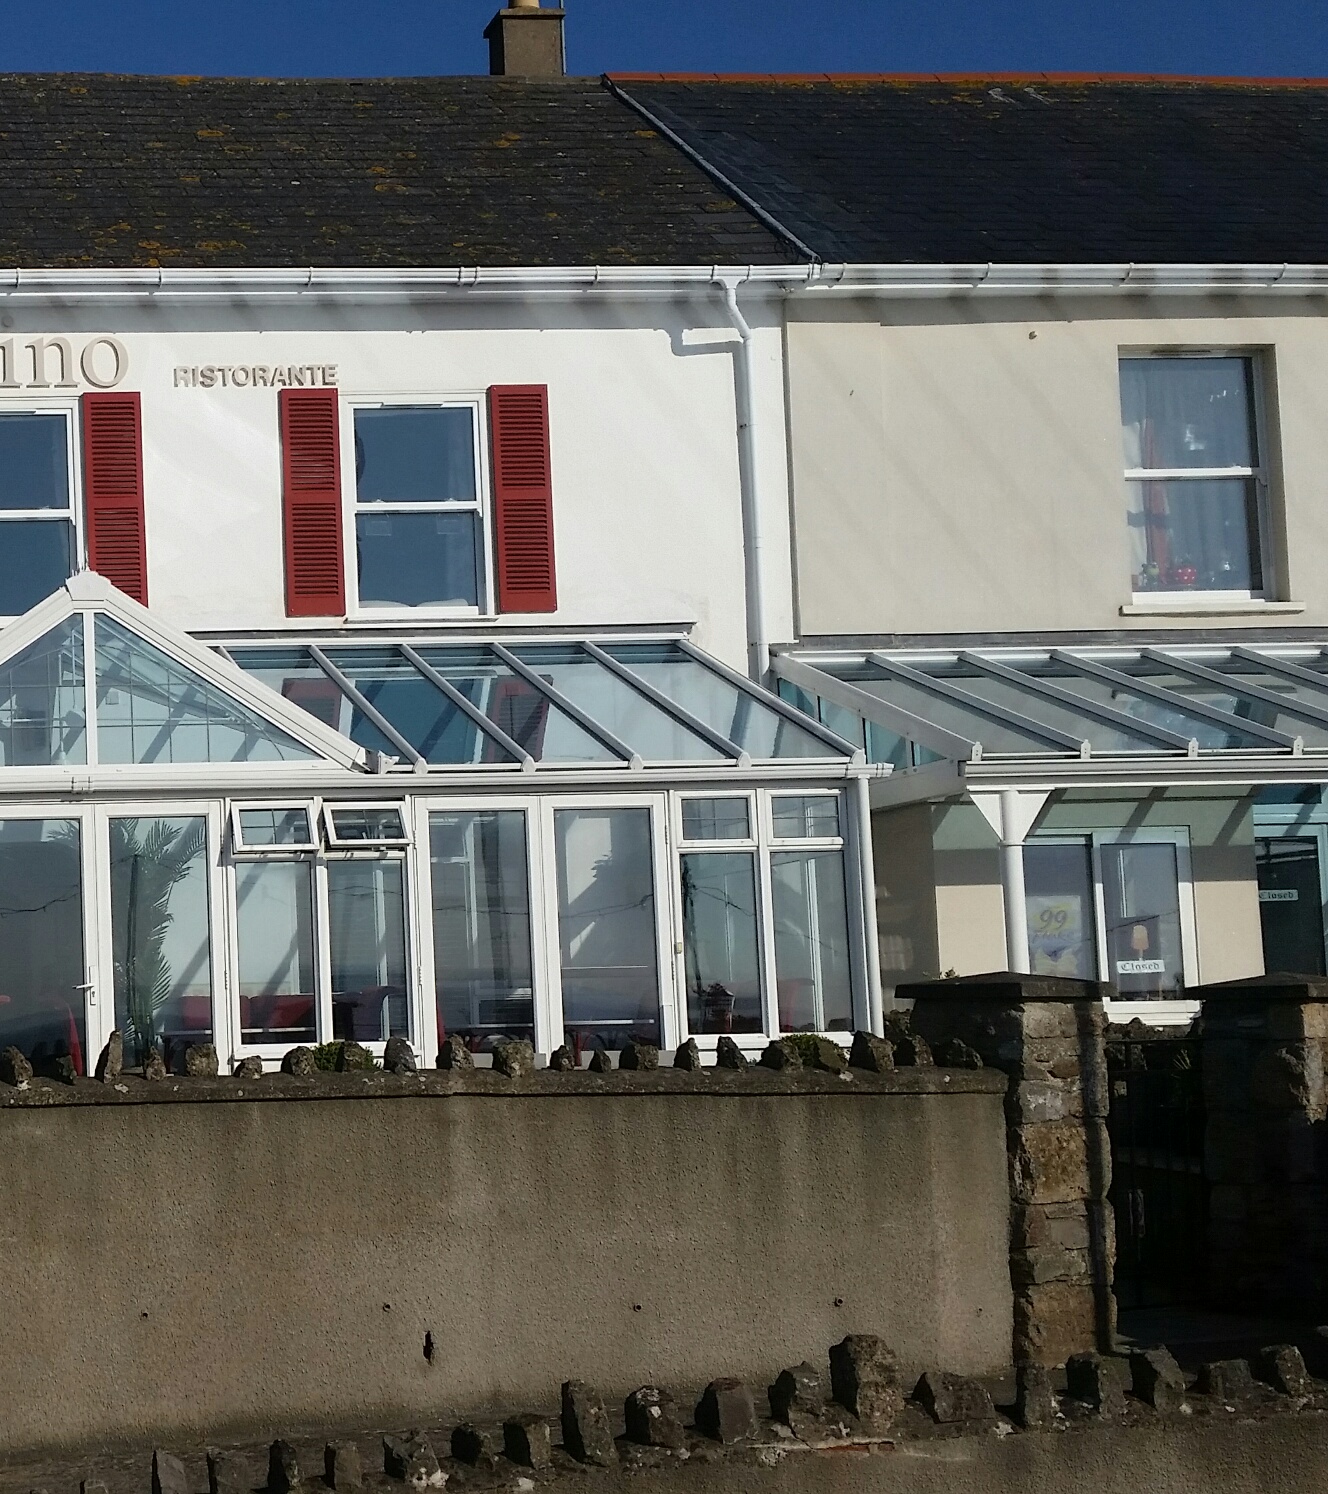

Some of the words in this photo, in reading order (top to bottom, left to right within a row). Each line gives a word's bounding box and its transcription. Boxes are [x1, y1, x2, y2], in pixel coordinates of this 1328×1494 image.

[173, 364, 340, 388] RISTORANTE
[1259, 891, 1294, 900] Closed
[1039, 909, 1068, 930] 99
[1121, 962, 1160, 971] Closed
